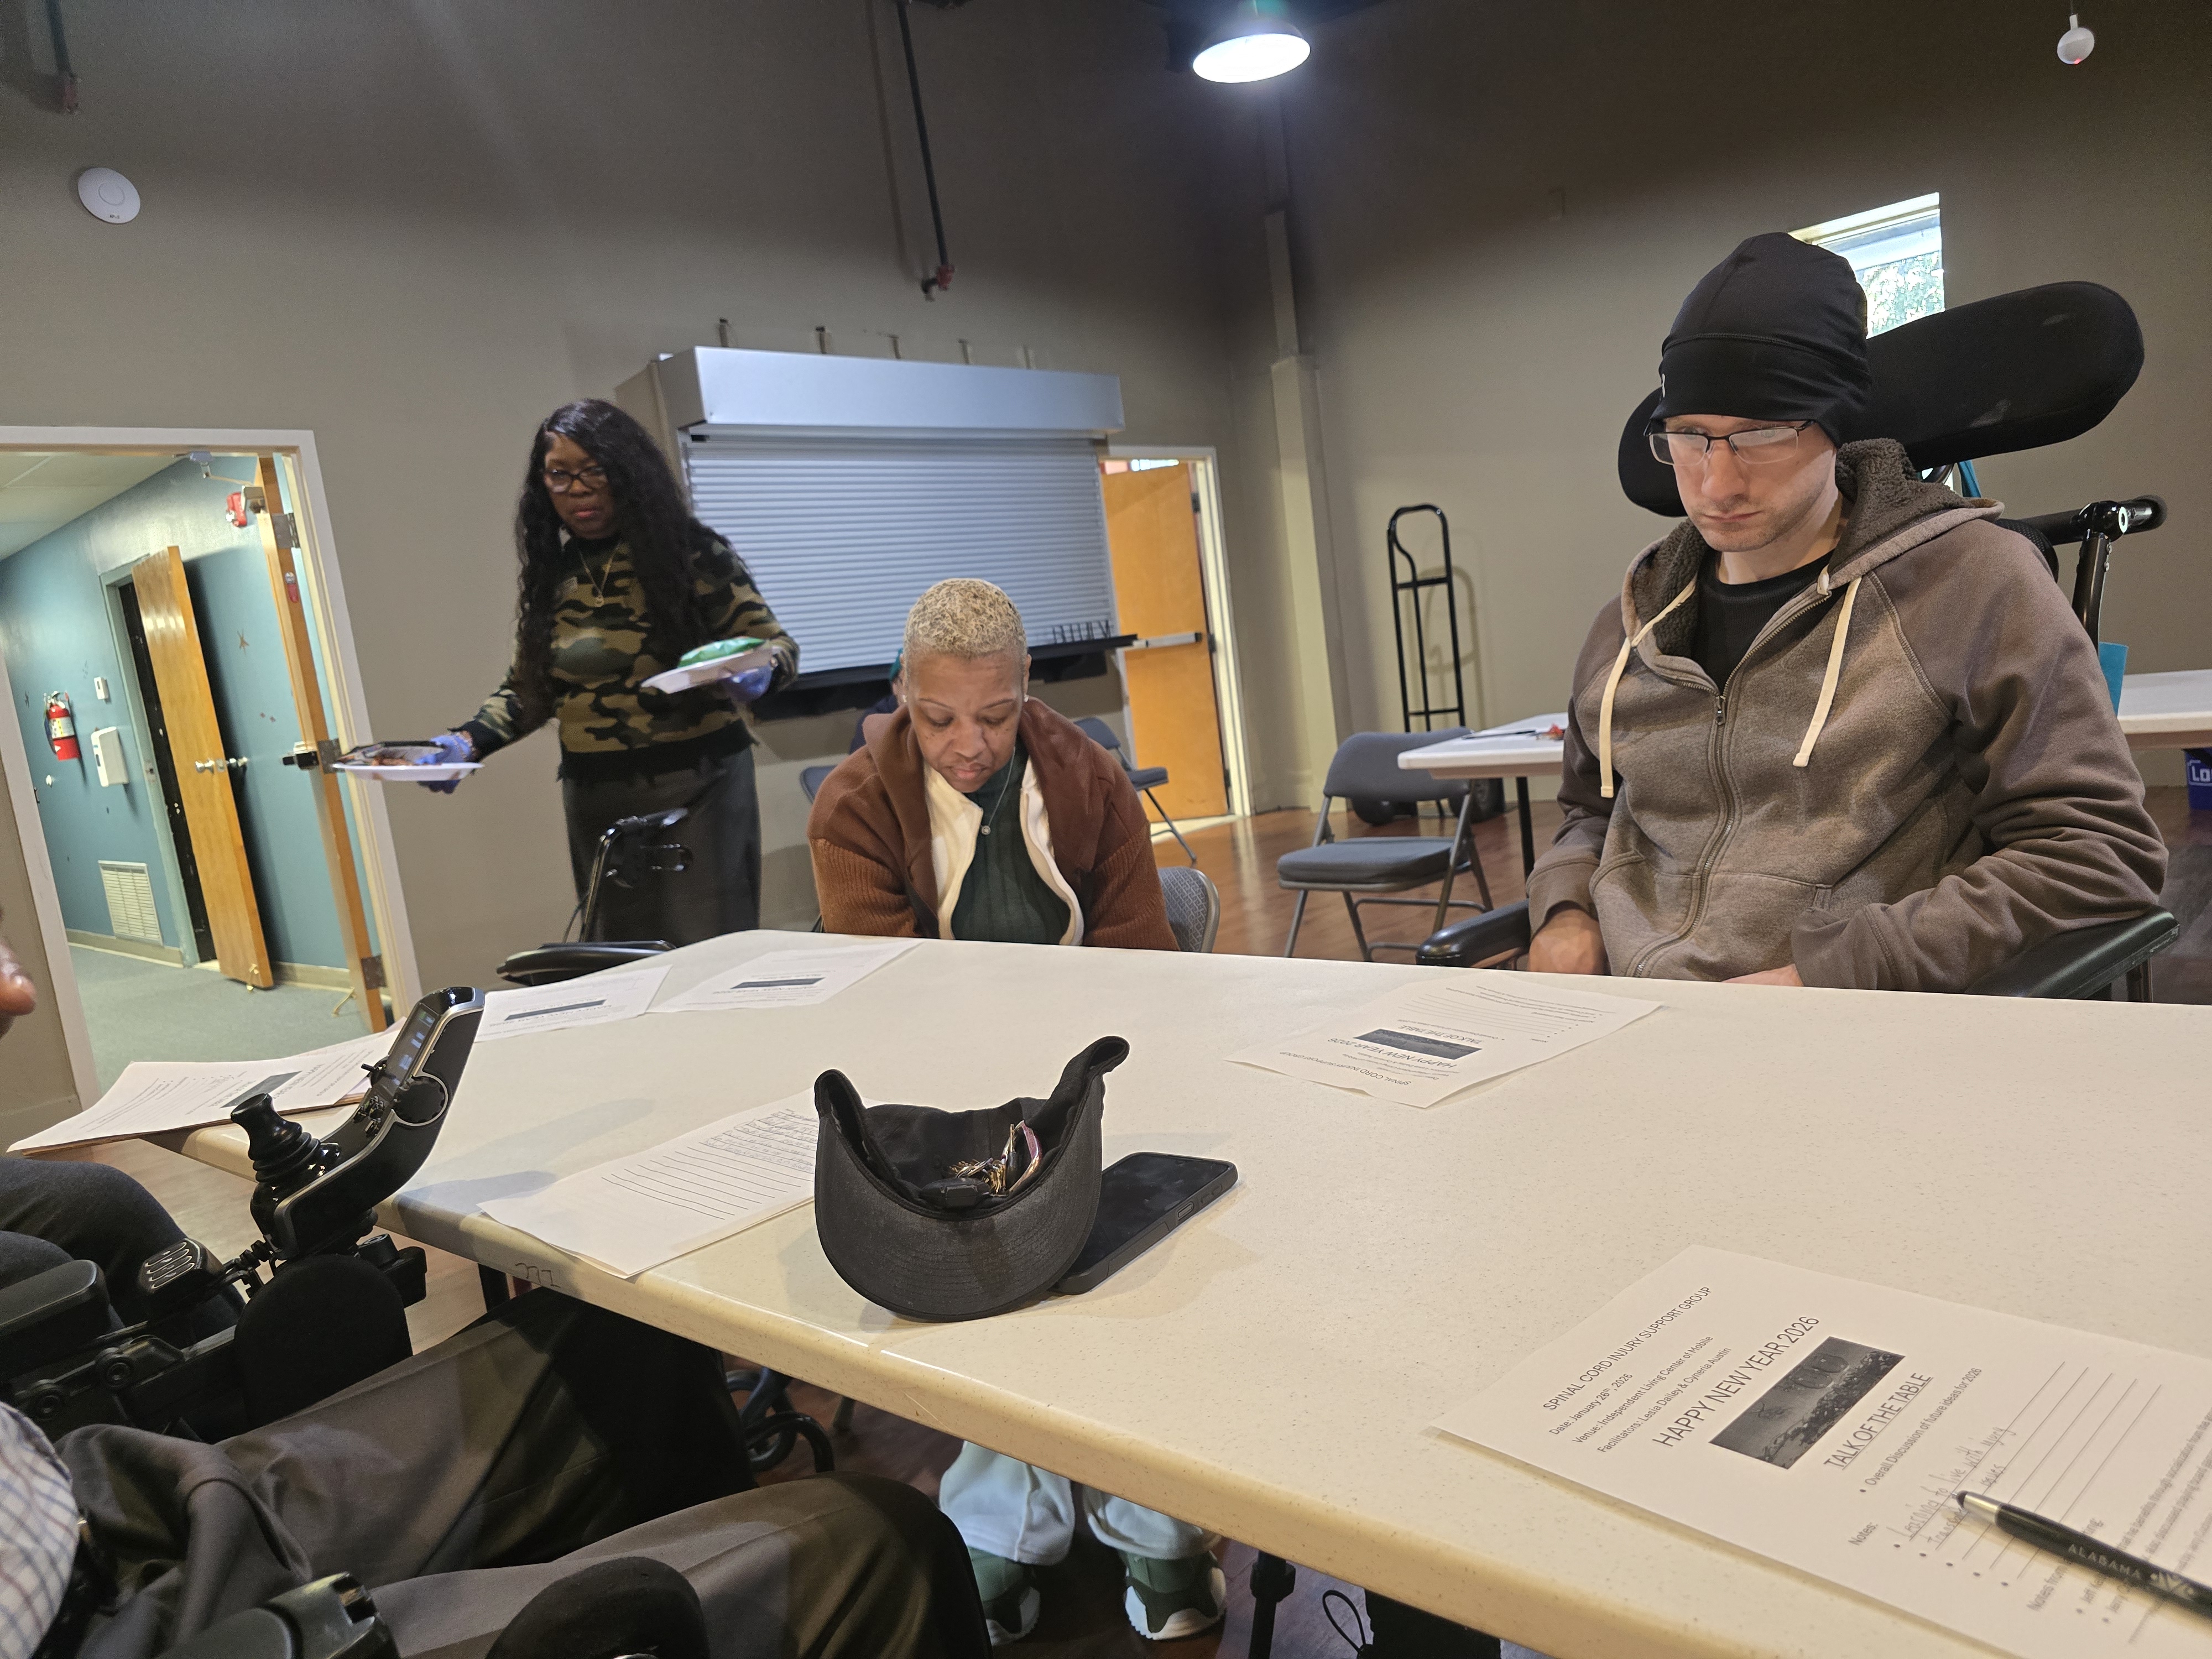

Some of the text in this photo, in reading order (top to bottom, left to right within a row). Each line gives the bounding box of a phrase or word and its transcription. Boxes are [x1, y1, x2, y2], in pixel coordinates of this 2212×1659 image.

[1359, 1069, 1384, 1079] CORD
[1382, 1051, 1416, 1061] NEW
[1412, 1057, 1457, 1068] HAPPY
[1543, 1287, 1712, 1410] SPINAL CORD INJURY SUPPORT GROUP
[1652, 1316, 1819, 1447] HAPPY NEW YEAR 2026
[1548, 1420, 1574, 1435] Date:
[1569, 1399, 1602, 1421] January
[1611, 1373, 1633, 1388] 2026
[1572, 1424, 1603, 1443] Venue:
[1597, 1390, 1646, 1425] Independent
[1640, 1374, 1667, 1391] Living
[1659, 1358, 1686, 1375] Center
[1687, 1337, 1713, 1354] Mobile
[1597, 1421, 1644, 1453] Facilitators:
[1637, 1405, 1662, 1422] Lesia
[1656, 1387, 1684, 1406] Dailey
[1683, 1364, 1713, 1384] Cyneria
[1707, 1348, 1731, 1365] Austin
[1823, 1373, 1932, 1468] TALK OF THE TABLE
[1864, 1368, 1982, 1486] Overall Discussion of future ideas for 2026
[1848, 1522, 1879, 1546] Notes:
[2068, 1543, 2141, 1579] ALABAMA
